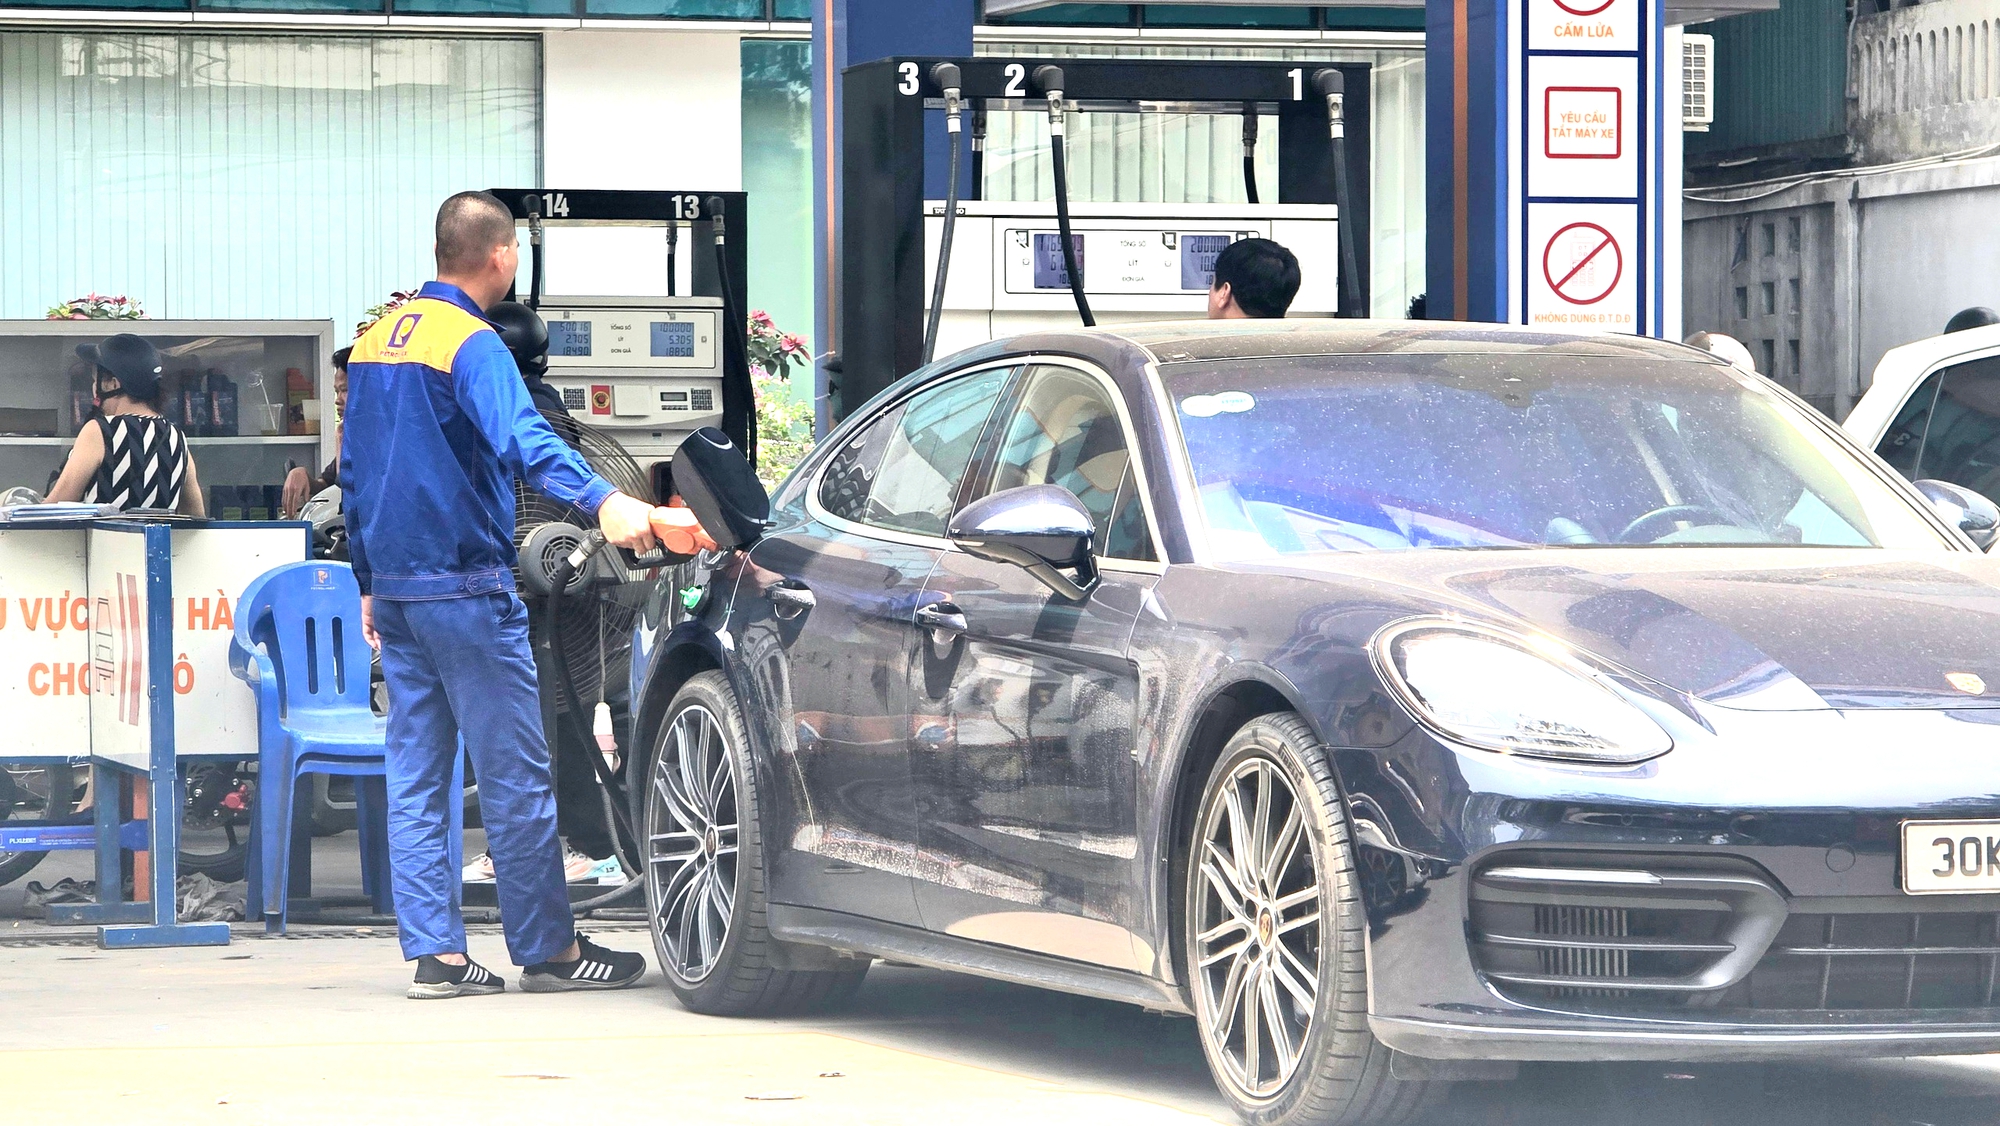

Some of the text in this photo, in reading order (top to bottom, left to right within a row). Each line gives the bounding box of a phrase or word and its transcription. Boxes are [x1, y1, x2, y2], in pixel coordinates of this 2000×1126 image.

[1554, 21, 1614, 37] CẤM LỬA
[898, 62, 920, 96] 3
[1004, 63, 1026, 97] 2
[1287, 68, 1302, 101] 1
[1560, 109, 1606, 123] YÊU CẦU
[1552, 124, 1614, 138] TẮT MÁY XE
[542, 193, 570, 218] 14
[671, 194, 700, 219] 13
[1534, 311, 1567, 323] KHÔNG
[560, 322, 589, 331] 50016
[660, 322, 692, 332] 100000
[563, 346, 589, 355] 18490
[666, 347, 692, 357] 18850
[19, 590, 89, 639] VỰC
[188, 589, 236, 630] HÀ
[1932, 836, 2000, 877] 30K
